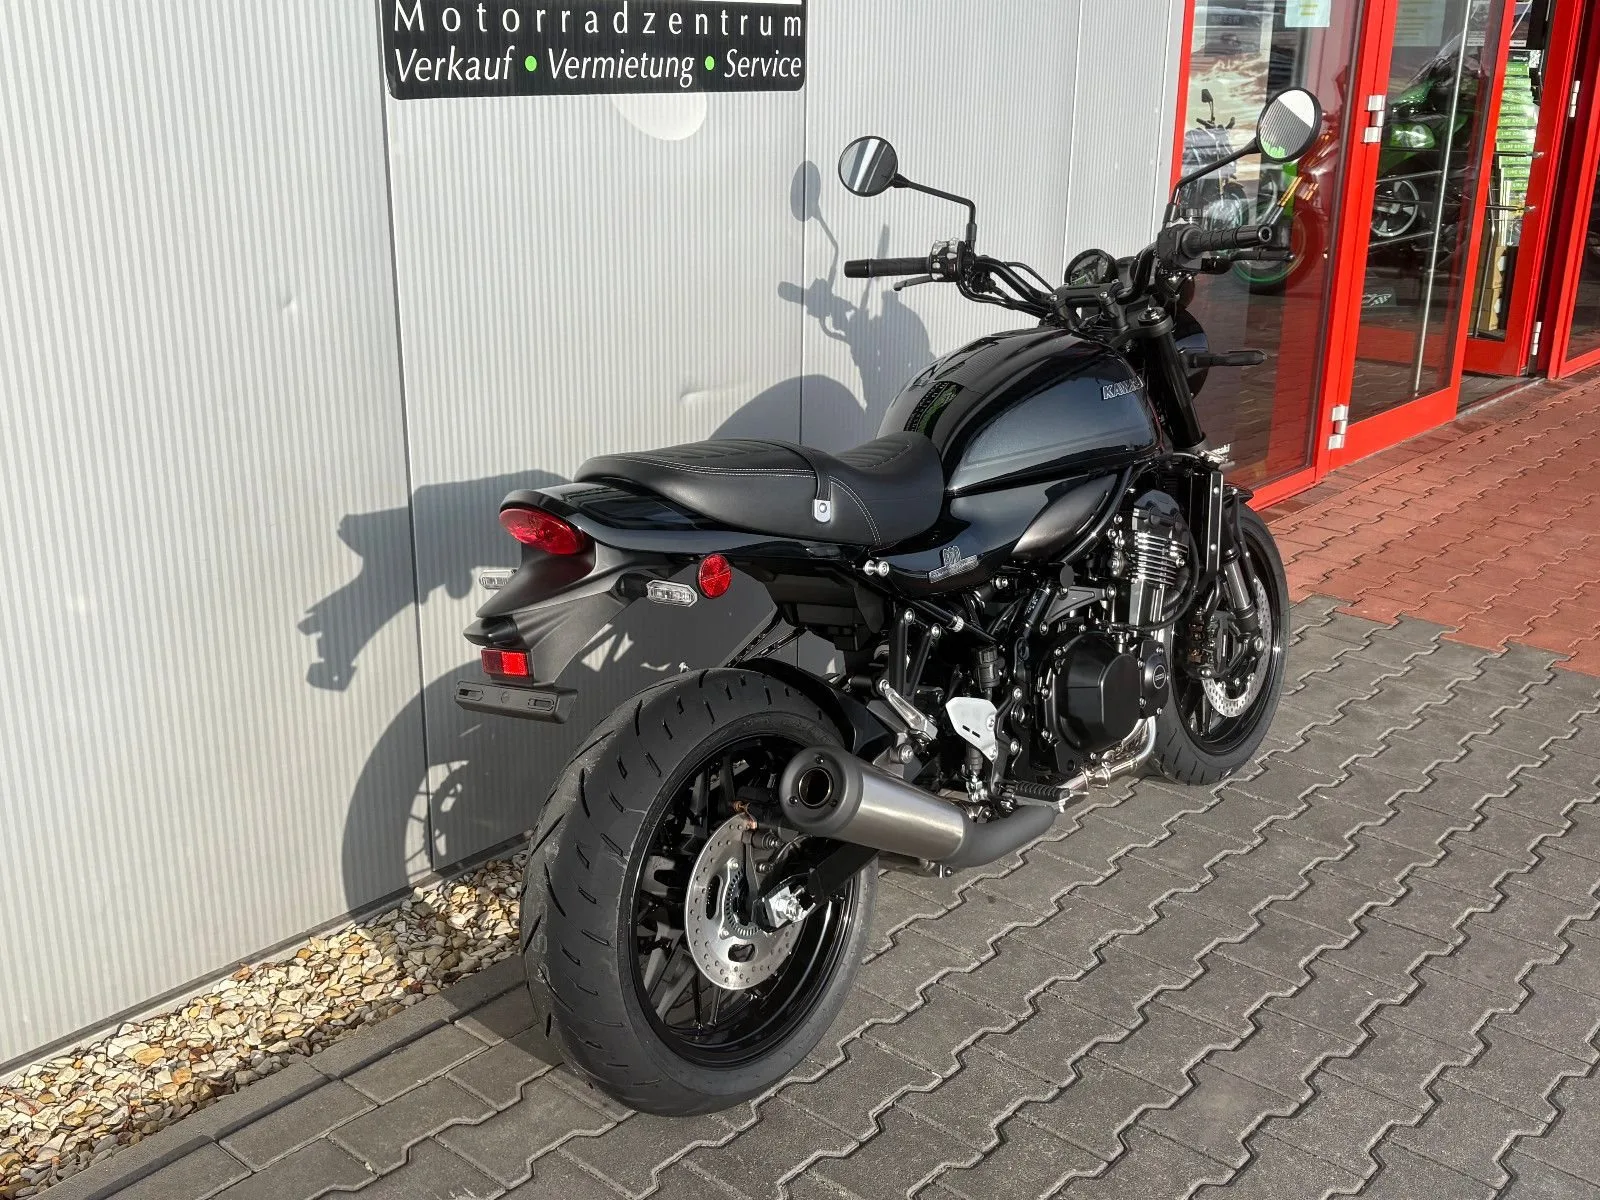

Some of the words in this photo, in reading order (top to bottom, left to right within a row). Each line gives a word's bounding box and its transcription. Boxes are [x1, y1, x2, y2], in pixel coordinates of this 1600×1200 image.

[393, 0, 802, 37] Motorradzentrum
[395, 45, 515, 82] Verkauf
[548, 48, 695, 88] Vermietung
[724, 48, 802, 78] Service
